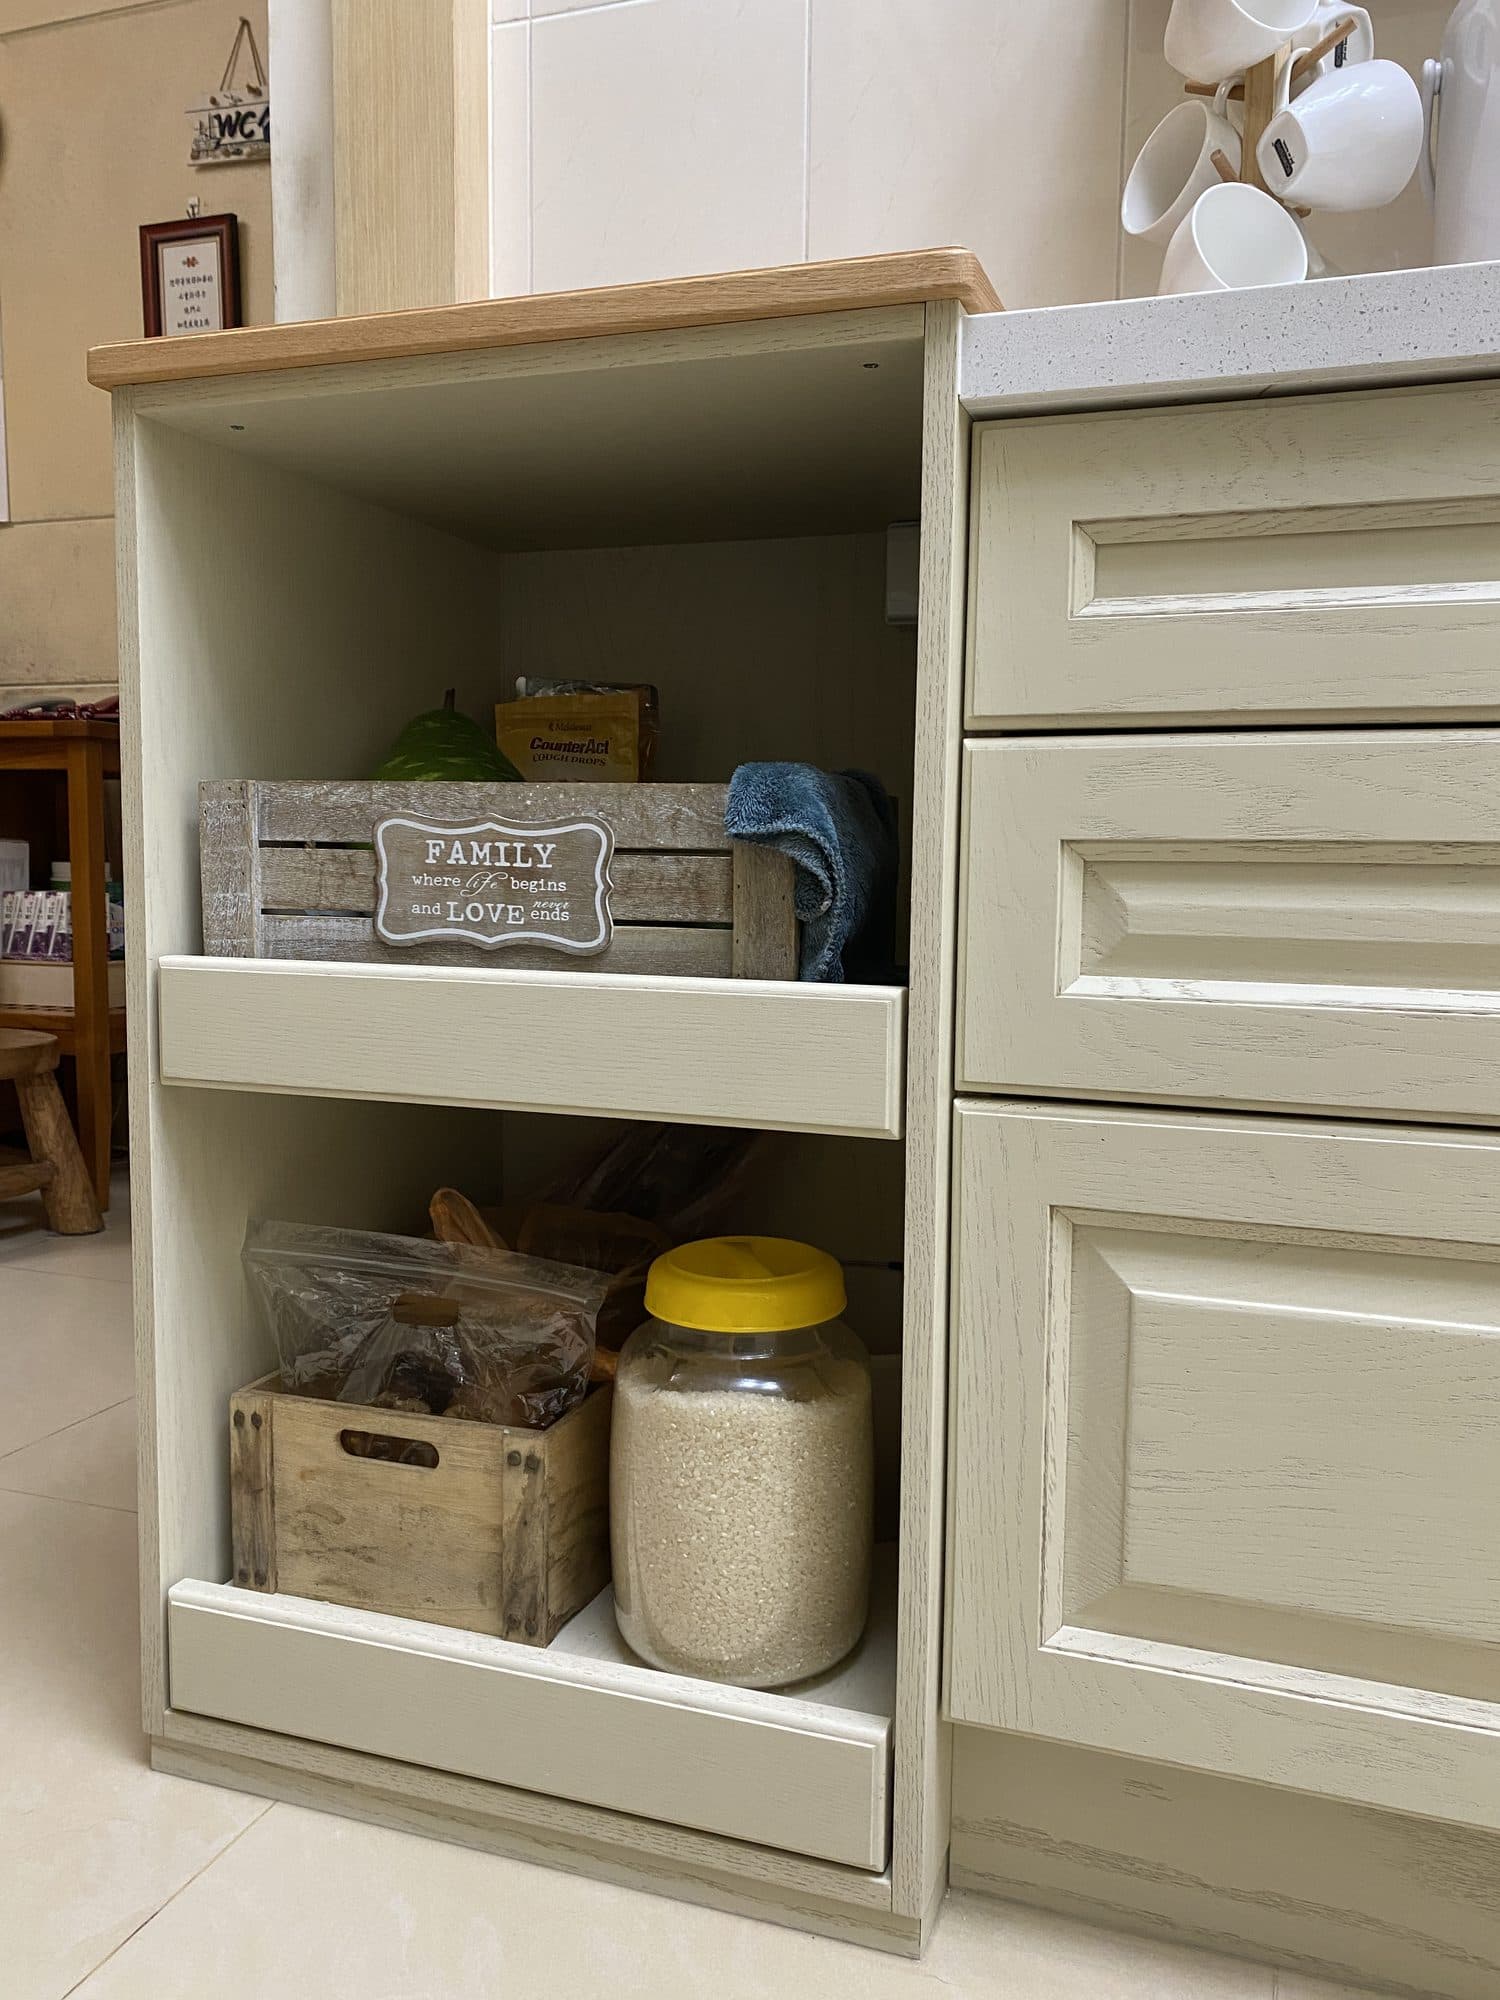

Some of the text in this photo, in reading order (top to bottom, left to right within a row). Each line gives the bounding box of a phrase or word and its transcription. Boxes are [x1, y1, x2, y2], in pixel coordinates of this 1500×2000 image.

[213, 110, 256, 139] WC
[530, 737, 609, 754] CounterAct
[532, 753, 607, 767] COUGH DROPS
[425, 839, 557, 868] FAMILY
[411, 871, 567, 897] where life begins
[411, 902, 442, 915] and
[446, 901, 525, 925] LOVE
[530, 908, 570, 921] ends
